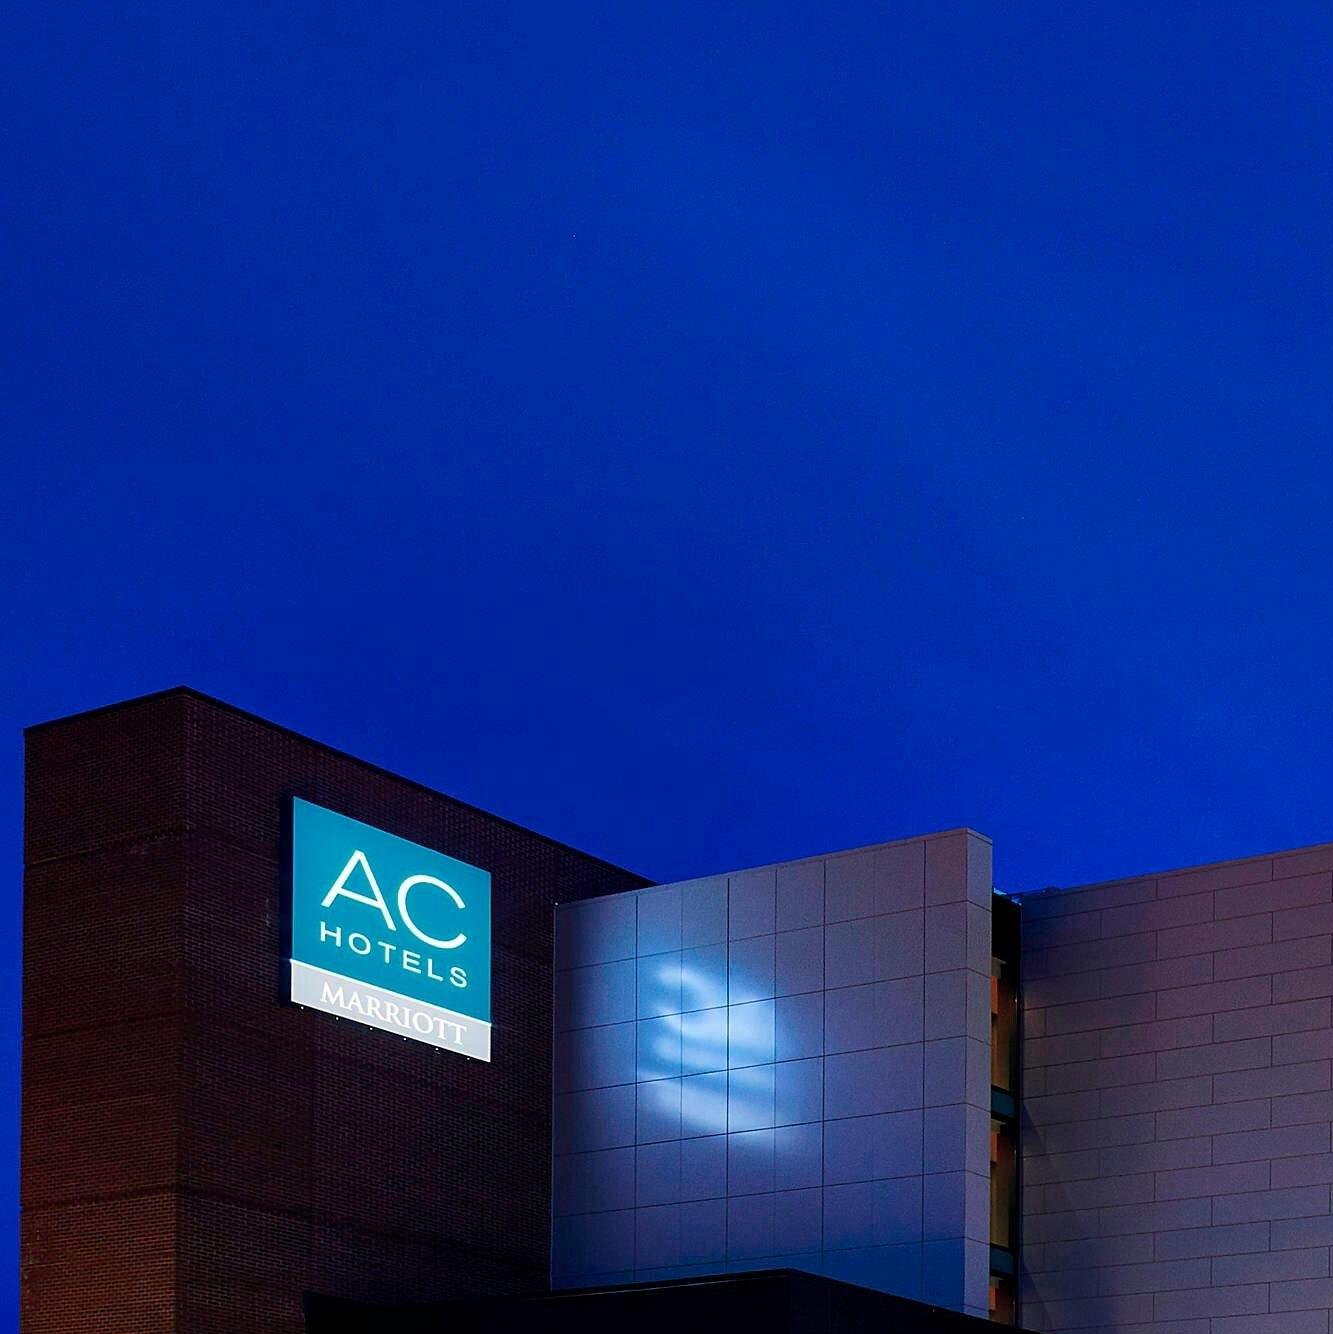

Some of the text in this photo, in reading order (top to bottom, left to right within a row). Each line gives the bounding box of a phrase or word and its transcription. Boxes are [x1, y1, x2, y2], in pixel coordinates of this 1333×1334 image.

[321, 850, 467, 949] AC
[320, 921, 468, 988] HOTELS
[320, 982, 467, 1045] MARRIOTT
